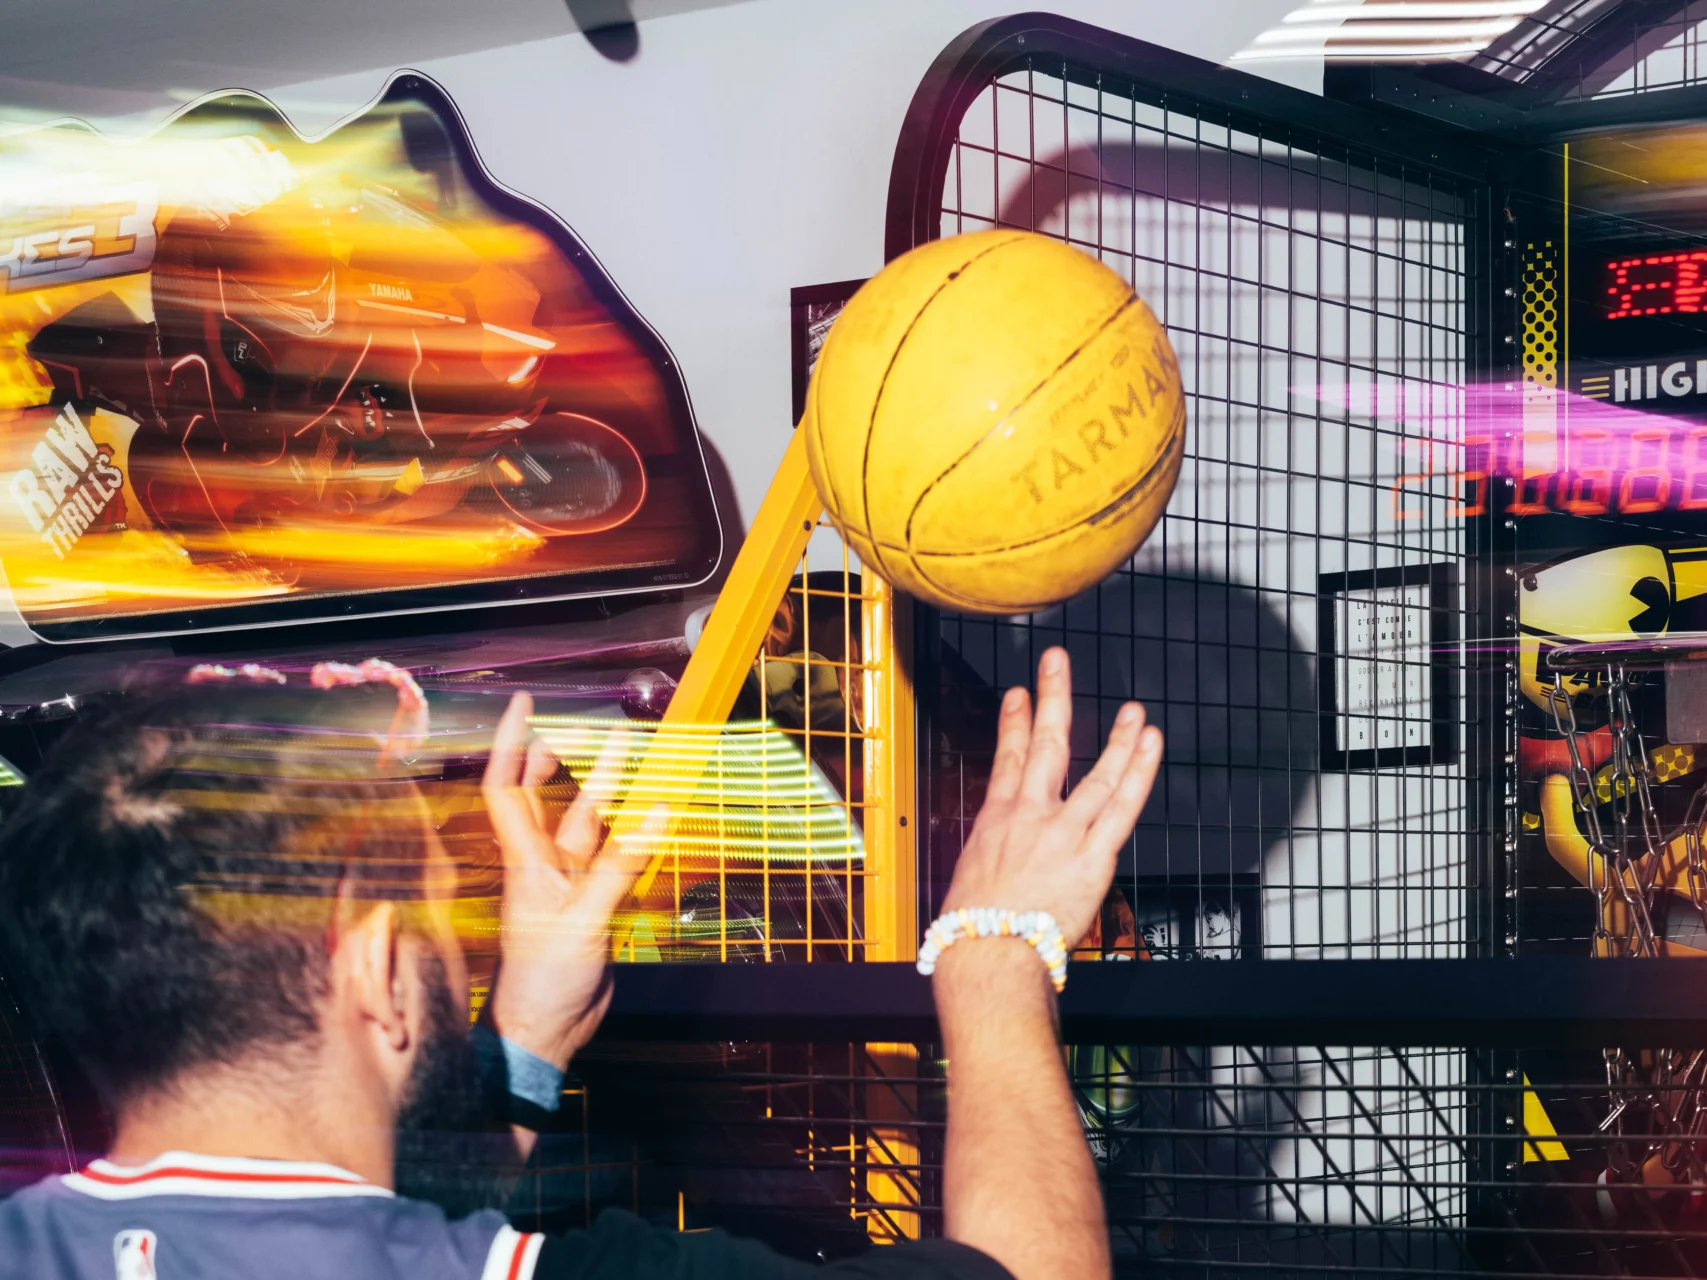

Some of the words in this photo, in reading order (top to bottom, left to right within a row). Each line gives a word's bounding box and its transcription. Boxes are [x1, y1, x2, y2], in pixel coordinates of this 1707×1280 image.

[369, 282, 413, 301] YAMAHA
[8, 401, 98, 533] RAW
[40, 453, 122, 561] THRILLS
[1385, 614, 1412, 624] COME
[1359, 728, 1414, 740] BON
